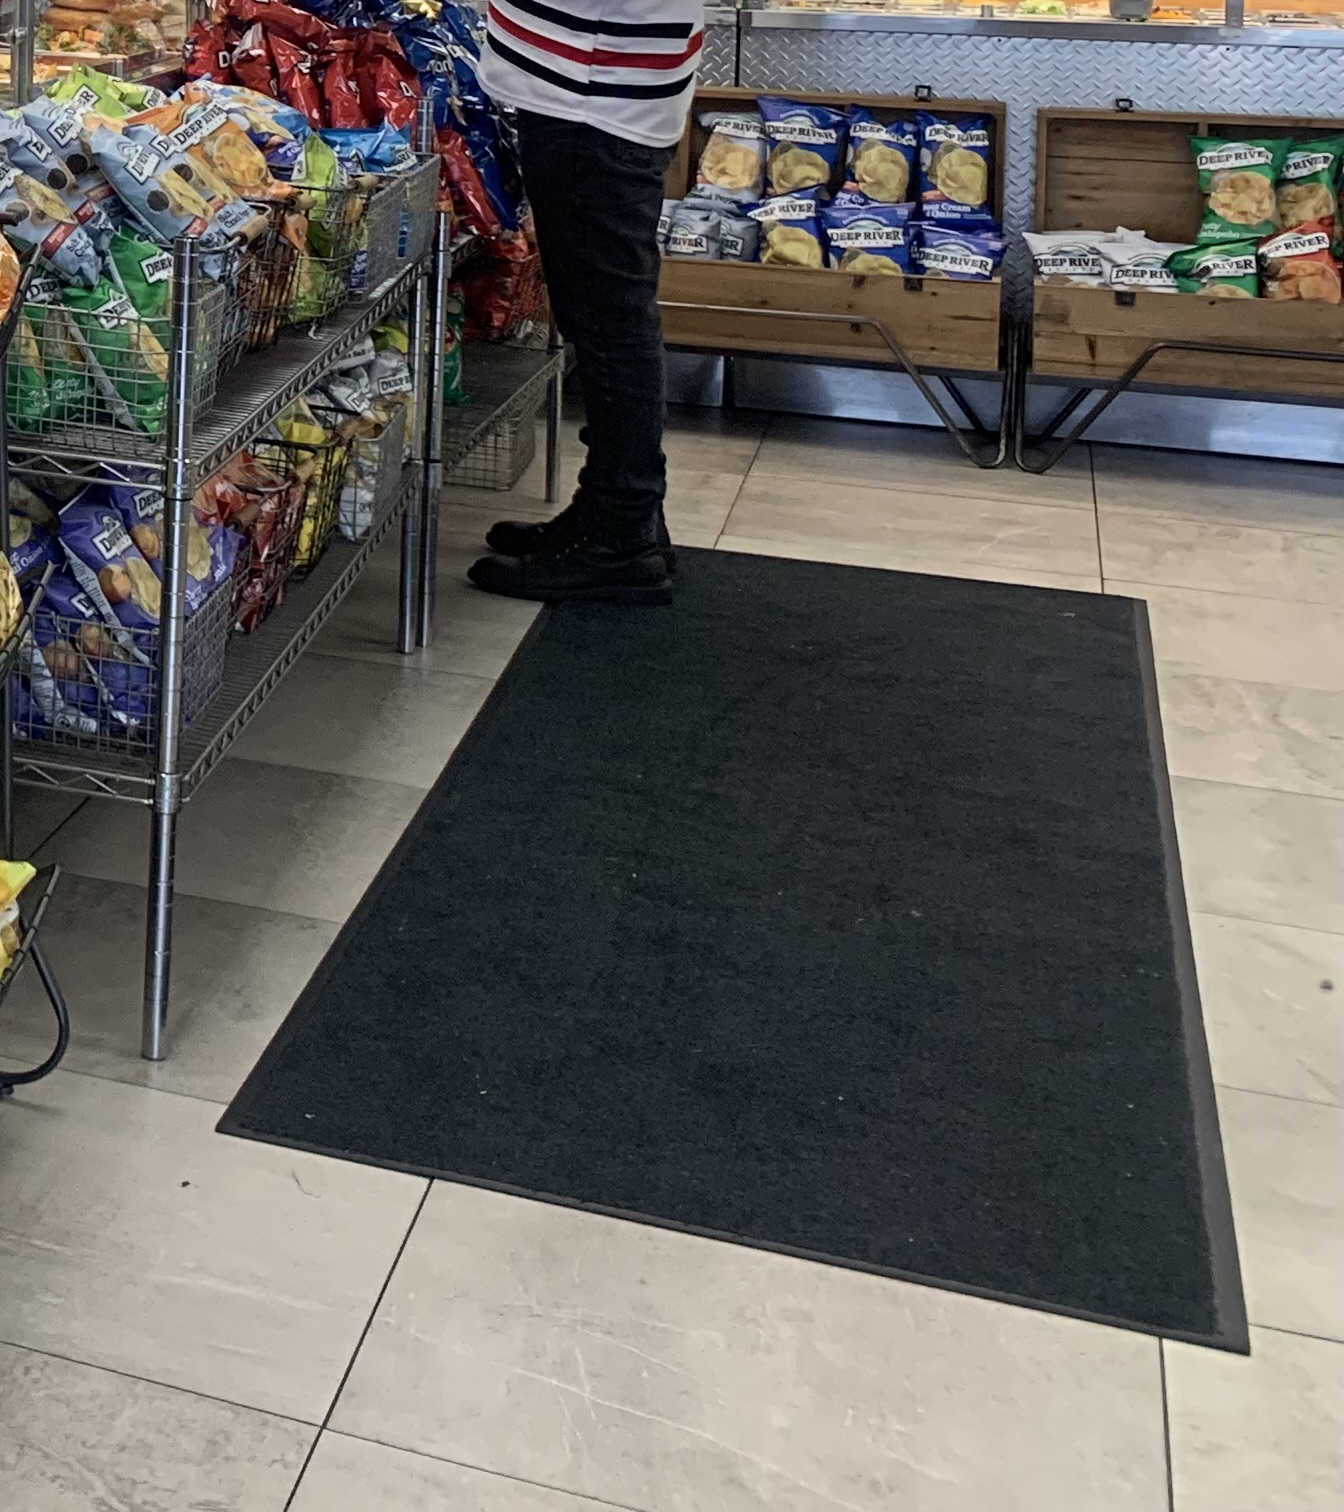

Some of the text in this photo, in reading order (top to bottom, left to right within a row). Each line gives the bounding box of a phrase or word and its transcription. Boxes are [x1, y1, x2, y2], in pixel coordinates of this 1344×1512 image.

[175, 106, 225, 144] DEEP RIVER
[766, 124, 835, 140] DEEP RIVER
[1199, 152, 1229, 166] DEEP
[830, 230, 903, 242] DEEP RIVER
